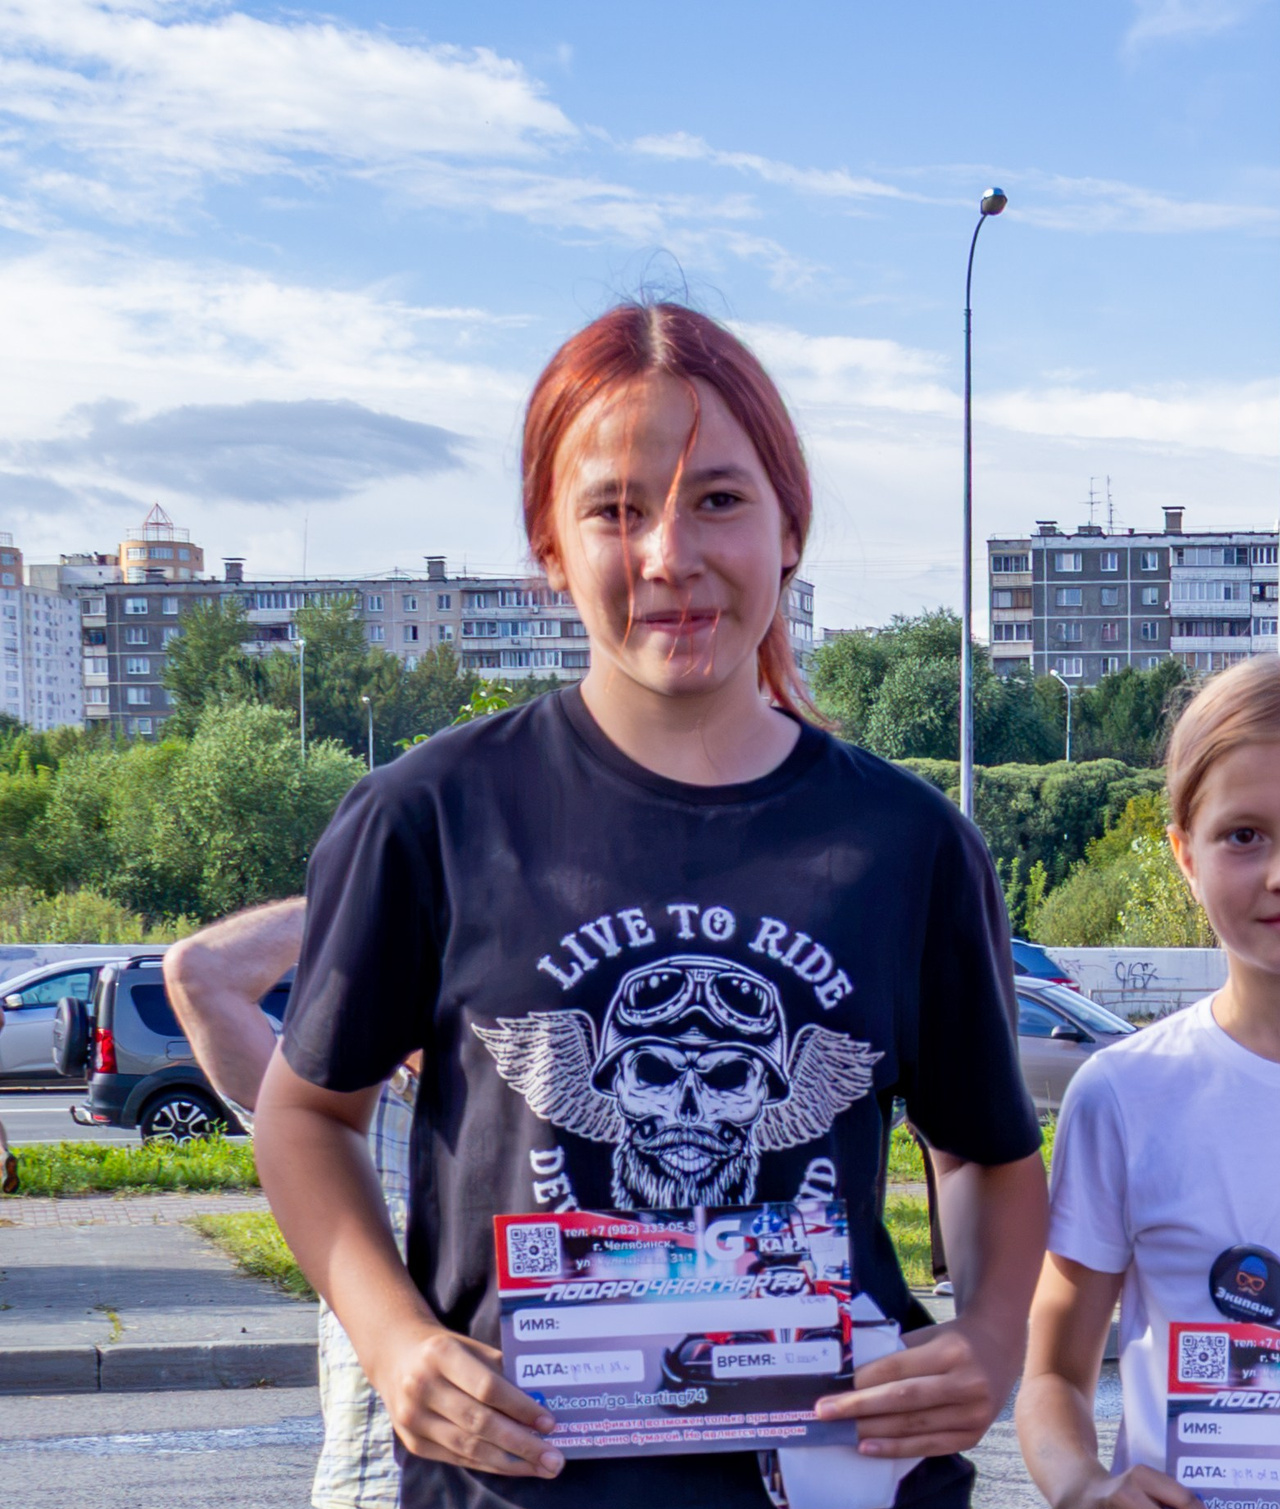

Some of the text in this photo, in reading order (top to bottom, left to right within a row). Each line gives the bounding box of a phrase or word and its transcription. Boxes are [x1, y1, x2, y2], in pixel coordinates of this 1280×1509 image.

[537, 903, 854, 1010] LIVE TO RIDE
[607, 1222, 639, 1236] (982)
[1215, 1286, 1274, 1317] Экипаж
[519, 1318, 560, 1332] ИМЯ:
[717, 1353, 776, 1369] ВРЕМЯ:
[522, 1363, 568, 1379] ДАТА:
[548, 1388, 708, 1411] vk.com/go_karting74
[1183, 1422, 1222, 1435] ИМЯ:
[1182, 1465, 1227, 1479] ДАТА:
